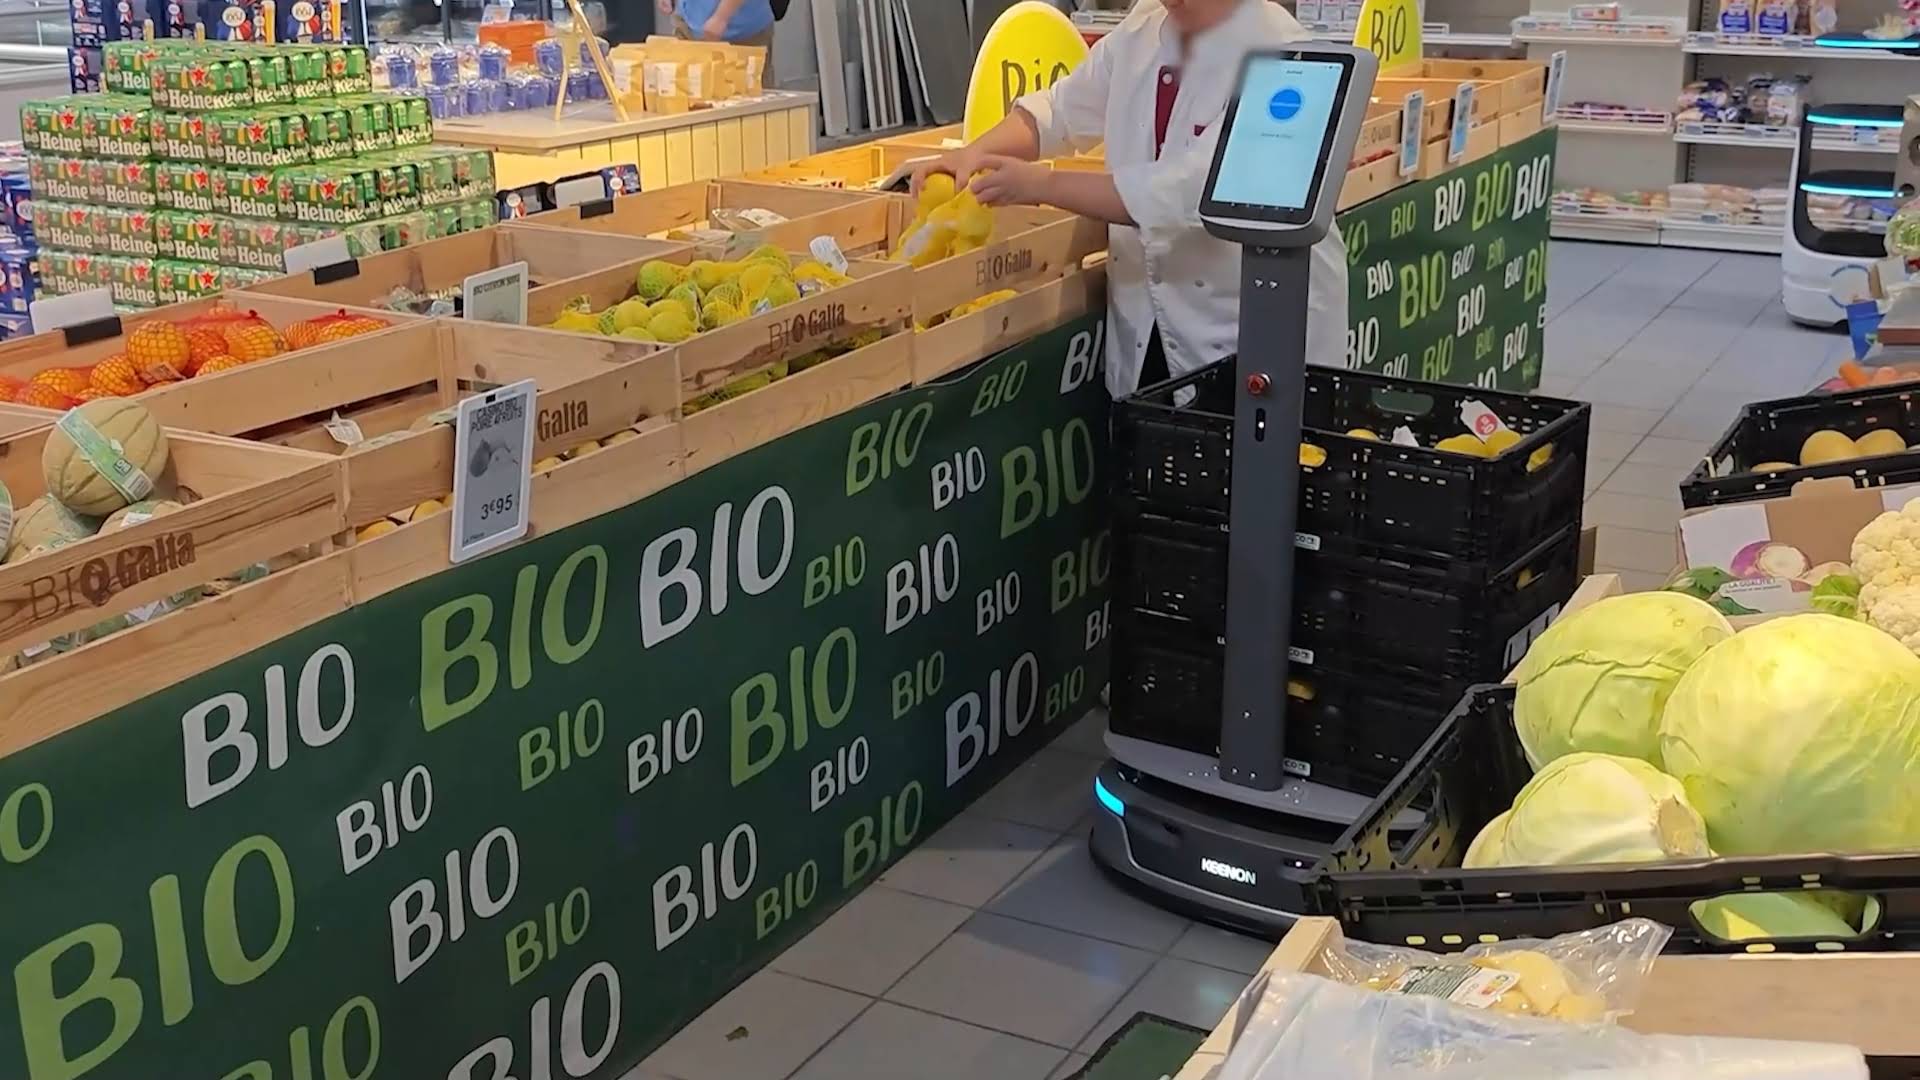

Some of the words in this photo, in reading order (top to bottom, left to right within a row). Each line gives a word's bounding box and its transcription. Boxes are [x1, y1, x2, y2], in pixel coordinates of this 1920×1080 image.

[1390, 200, 1416, 240] BIO
[1433, 177, 1466, 232] BIO
[1472, 160, 1512, 231] BIO
[1512, 154, 1550, 221] BIO
[1366, 259, 1394, 300] BIO
[1399, 251, 1446, 329] BIO
[1451, 243, 1475, 279] BIO
[1486, 237, 1506, 271] BIO
[1504, 255, 1523, 289] BIO
[1524, 241, 1548, 302] BI
[1457, 284, 1486, 338] BIO
[1475, 326, 1496, 361] BIO
[1503, 322, 1528, 372] BIO
[970, 359, 1029, 418] BIO
[1060, 320, 1105, 395] BI
[1422, 334, 1454, 381] BIO
[846, 401, 934, 497] BIO
[930, 446, 987, 512] BIO
[1000, 417, 1096, 540] BIO
[481, 494, 513, 520] 3€95
[639, 485, 796, 649] BIO
[803, 535, 867, 608] BIO
[885, 533, 961, 635] BIO
[975, 570, 1022, 636] BIO
[1051, 528, 1112, 614] BIO
[420, 544, 609, 732] BIO
[1085, 600, 1111, 651] BI
[730, 627, 858, 787] BIO
[891, 650, 945, 721] BIO
[945, 651, 1040, 789] BIO
[1043, 665, 1085, 725] BIO
[182, 643, 356, 809] BIO
[518, 698, 606, 793] BIO
[626, 707, 705, 795] BIO
[811, 736, 871, 814] BIO
[336, 764, 434, 875] BIO
[843, 780, 925, 890] BIO
[389, 826, 521, 984] BIO
[652, 823, 760, 952] BIO
[755, 860, 820, 940] BIO
[1201, 858, 1257, 885] KEENON
[14, 835, 296, 1080] BIO
[505, 886, 591, 987] BIO
